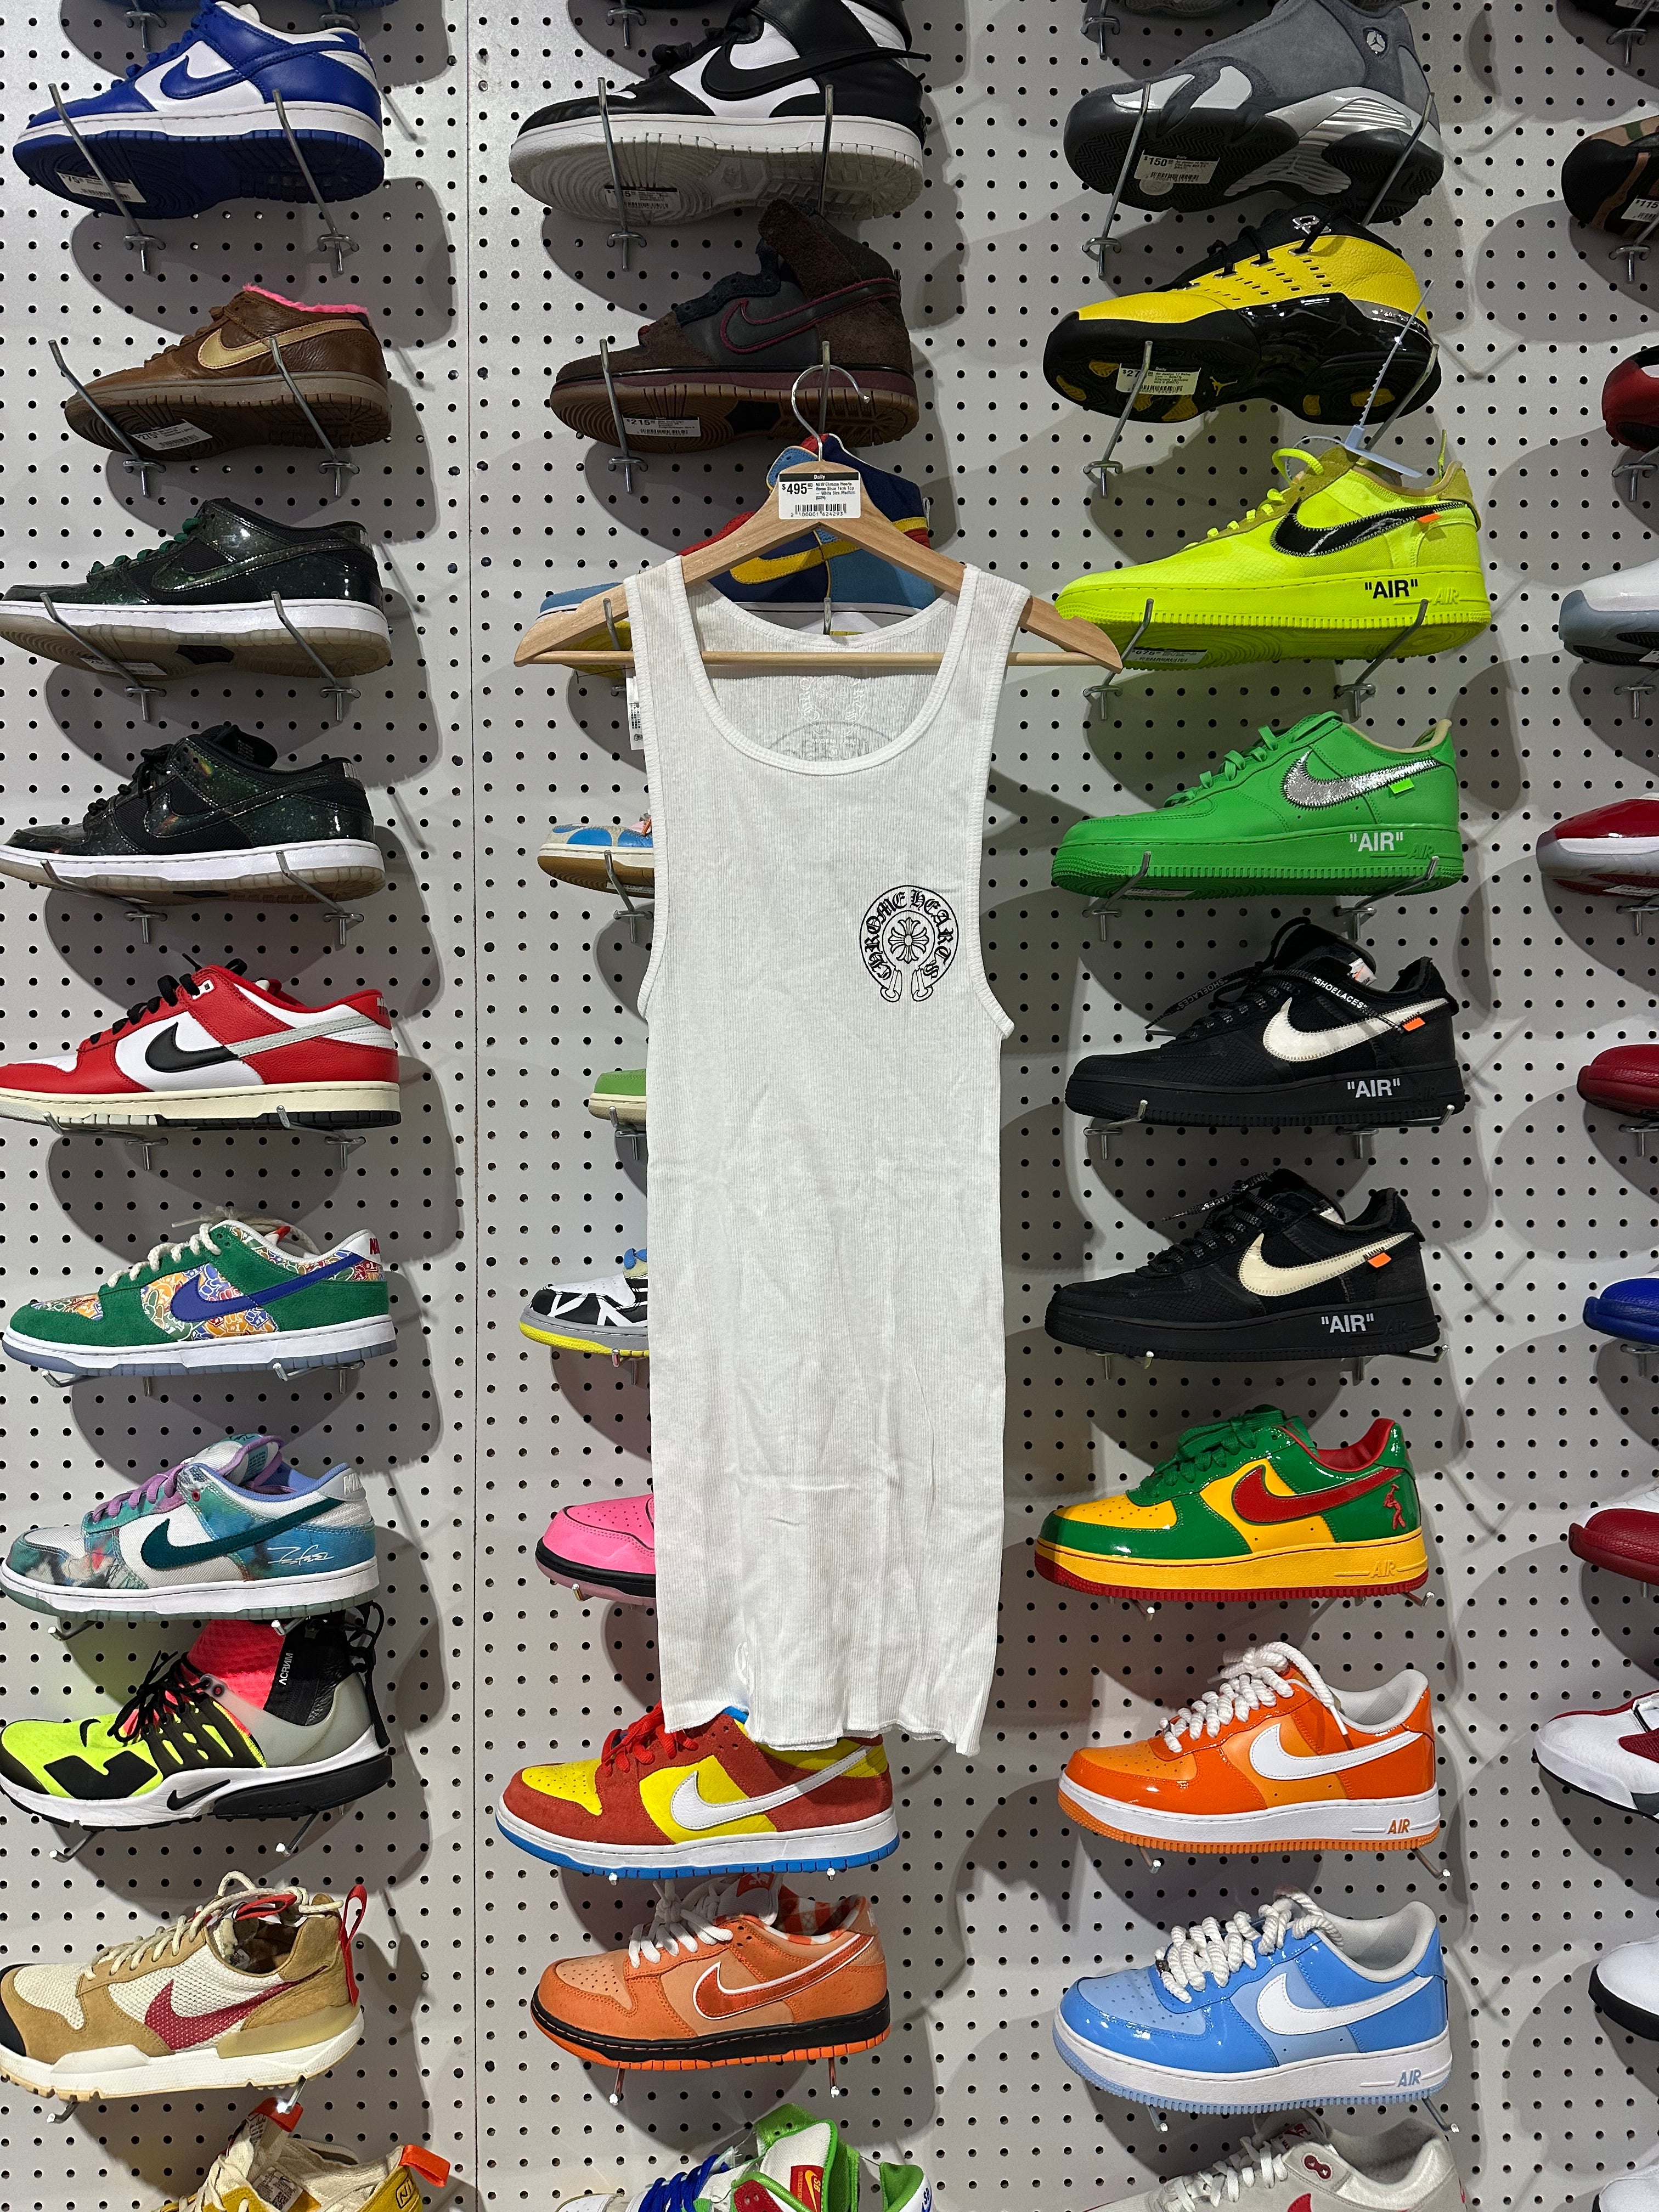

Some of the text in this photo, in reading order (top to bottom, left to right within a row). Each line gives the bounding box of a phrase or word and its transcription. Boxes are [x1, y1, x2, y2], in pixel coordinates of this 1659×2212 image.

[1144, 156, 1167, 166] $150
[782, 483, 807, 494] $495
[1364, 578, 1418, 599] "AIR"
[1432, 588, 1459, 606] AIR
[1350, 832, 1404, 852] "AIR"
[865, 889, 953, 980] CHROME HEARTS
[1313, 977, 1368, 1008] "SHOELACES"
[1347, 1077, 1401, 1098] "AIR"
[1321, 1313, 1375, 1333] "AIR"
[1369, 1559, 1396, 1578] AIR
[1386, 1818, 1410, 1835] AIR
[1397, 2068, 1421, 2087] AIR
